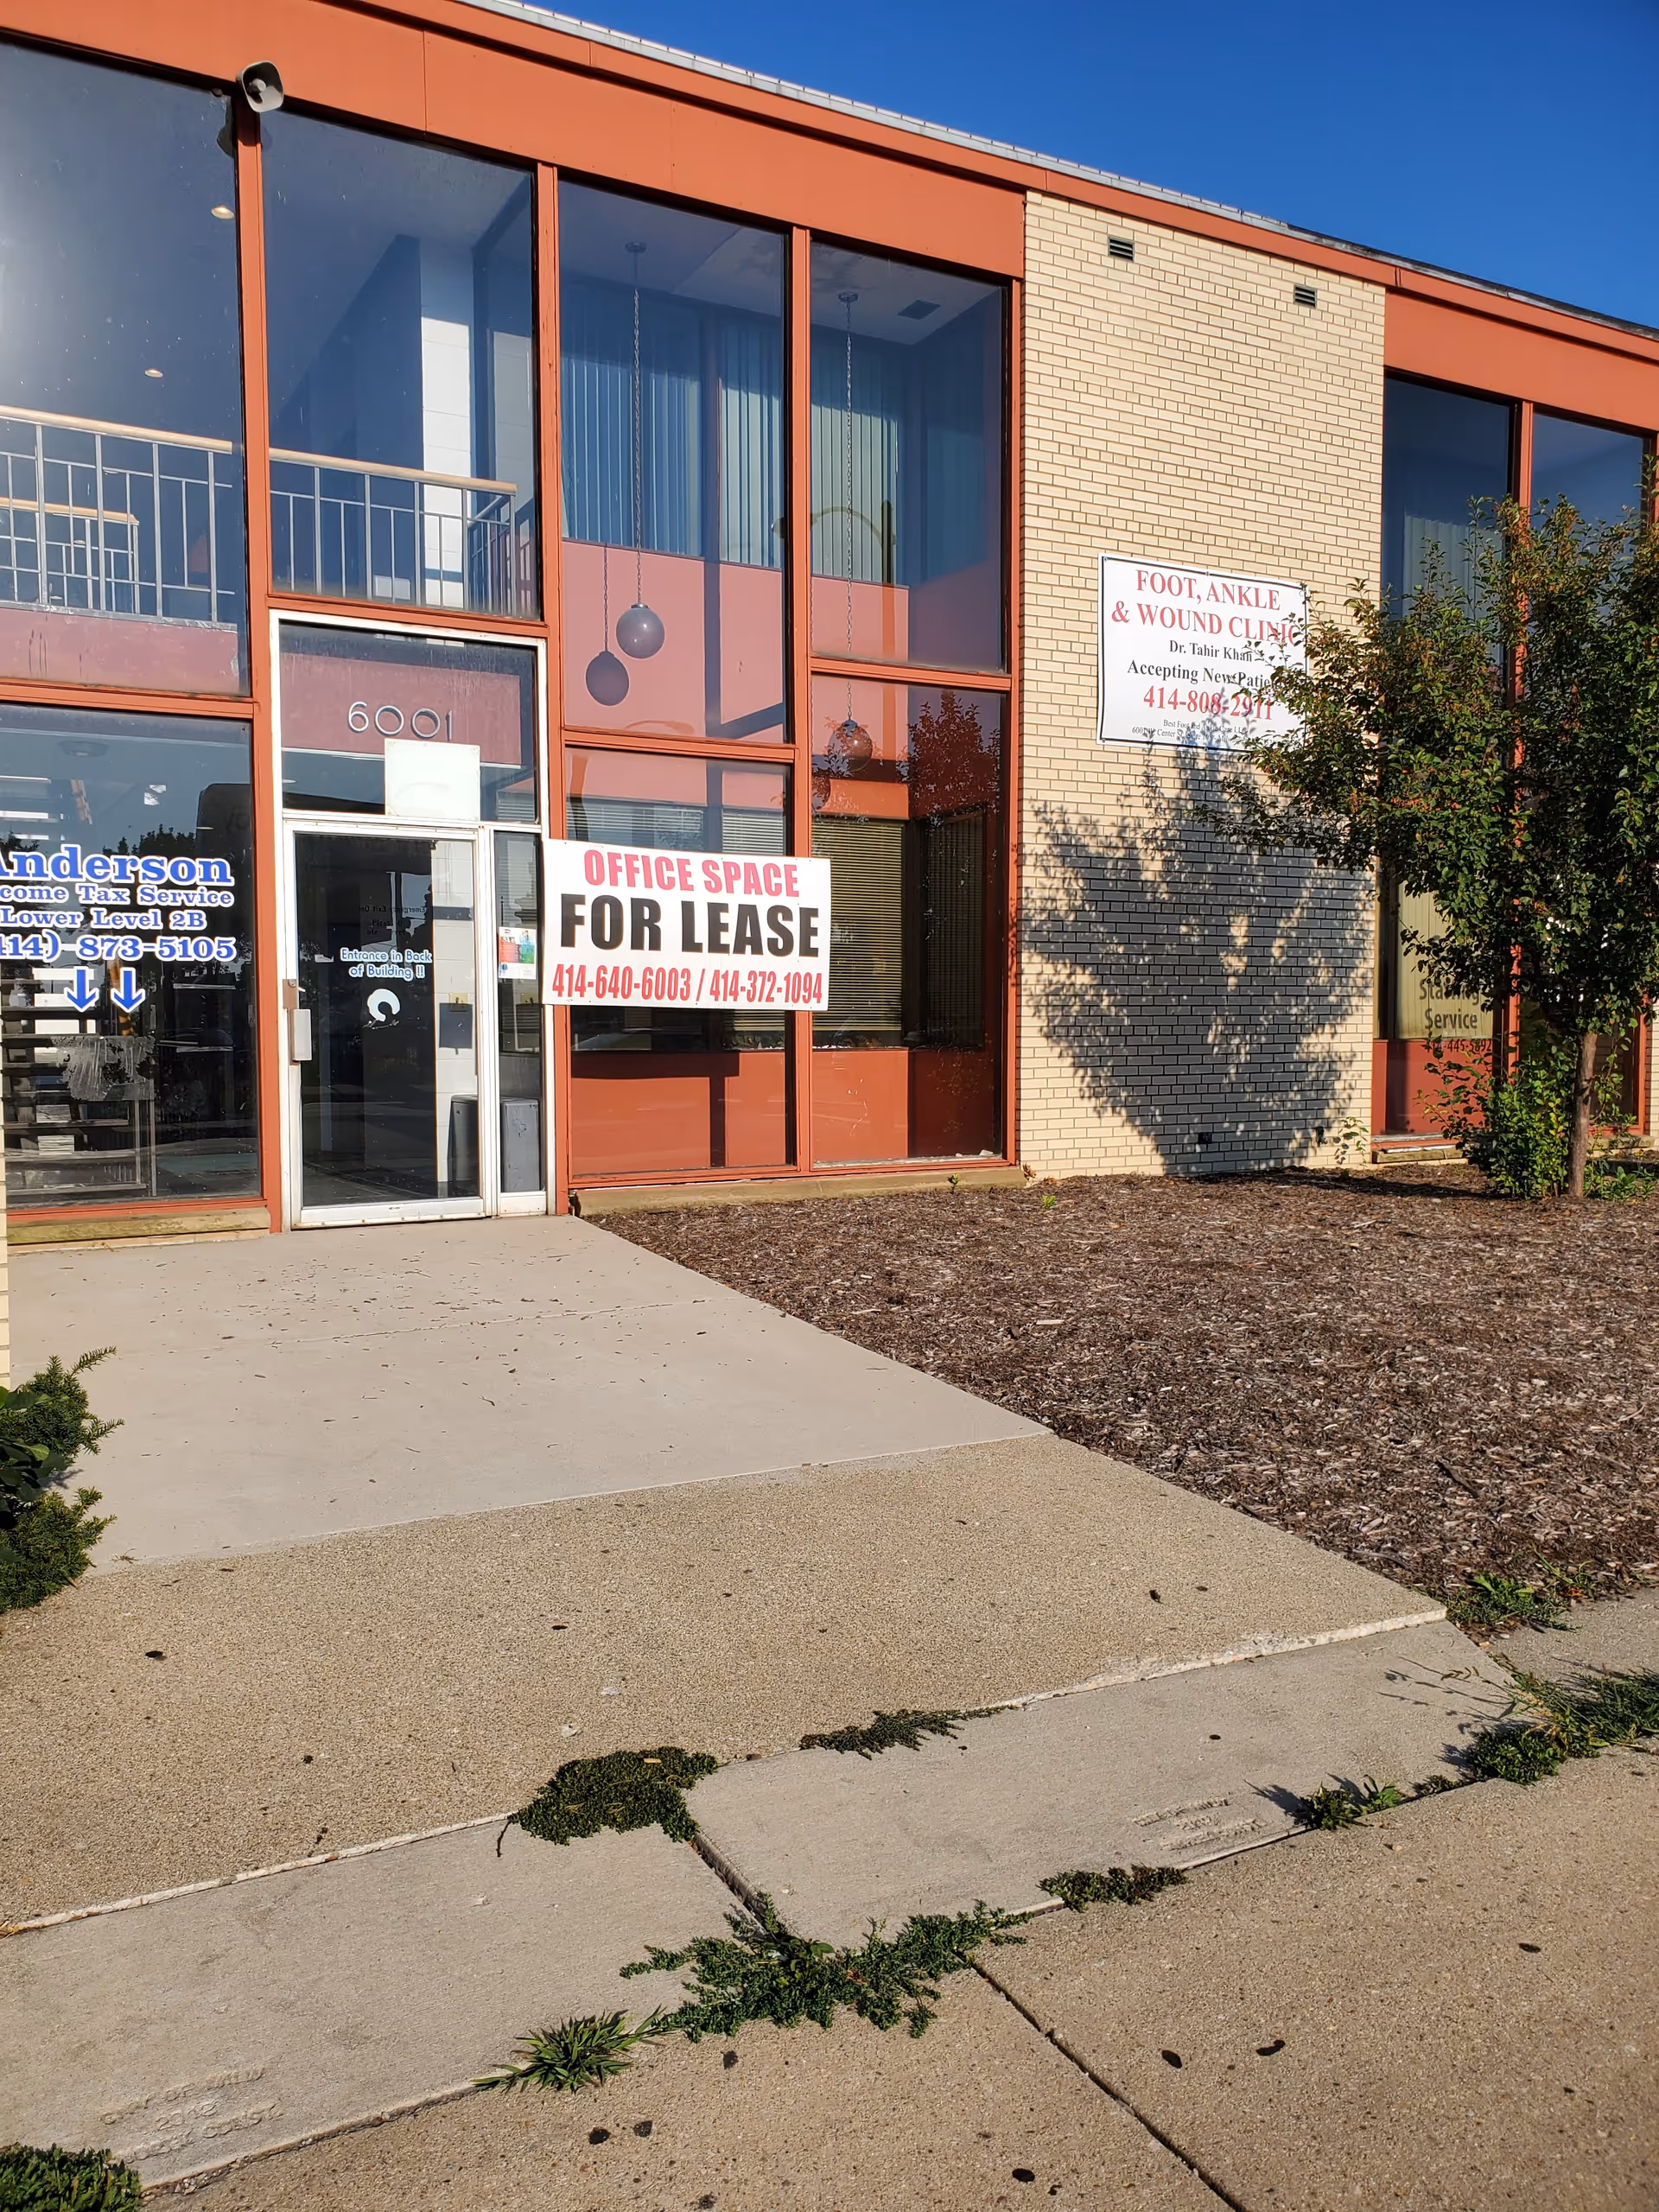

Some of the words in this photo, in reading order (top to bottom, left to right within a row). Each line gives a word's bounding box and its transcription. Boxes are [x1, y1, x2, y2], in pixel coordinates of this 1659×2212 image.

[1135, 569, 1202, 605] FOOT,
[1206, 581, 1281, 611] ANKLE
[1111, 601, 1130, 624] &
[1136, 603, 1222, 634] WOUND
[1229, 616, 1300, 647] CLINIC
[1169, 640, 1186, 654] Dr.
[1190, 643, 1220, 658] Tahir
[1224, 647, 1252, 662] Khan
[1127, 660, 1198, 684] Accepting
[1203, 667, 1232, 683] New
[1237, 671, 1279, 688] Patie
[348, 701, 453, 740] 6001
[1157, 728, 1176, 738] Center
[0, 845, 232, 885] nderson
[584, 849, 695, 891] OFFICE
[702, 860, 799, 897] SPACE
[0, 886, 67, 901] come
[78, 886, 128, 902] Tax
[137, 887, 232, 906] Service
[0, 907, 82, 926] Lower
[92, 910, 161, 928] Level
[171, 912, 206, 928] 2B
[561, 893, 662, 951] FOR
[681, 900, 819, 957] LEASE
[78, 936, 236, 960] 873-5105
[340, 948, 387, 961] Entrance
[392, 950, 402, 961] in
[406, 950, 432, 962] Back
[350, 965, 364, 976] of
[367, 965, 413, 980] Building
[416, 965, 424, 976] !!
[552, 963, 690, 1001] 414-640-6003
[696, 969, 706, 1001] /
[709, 969, 823, 1004] 414-372-1094
[1425, 1007, 1478, 1029] Service
